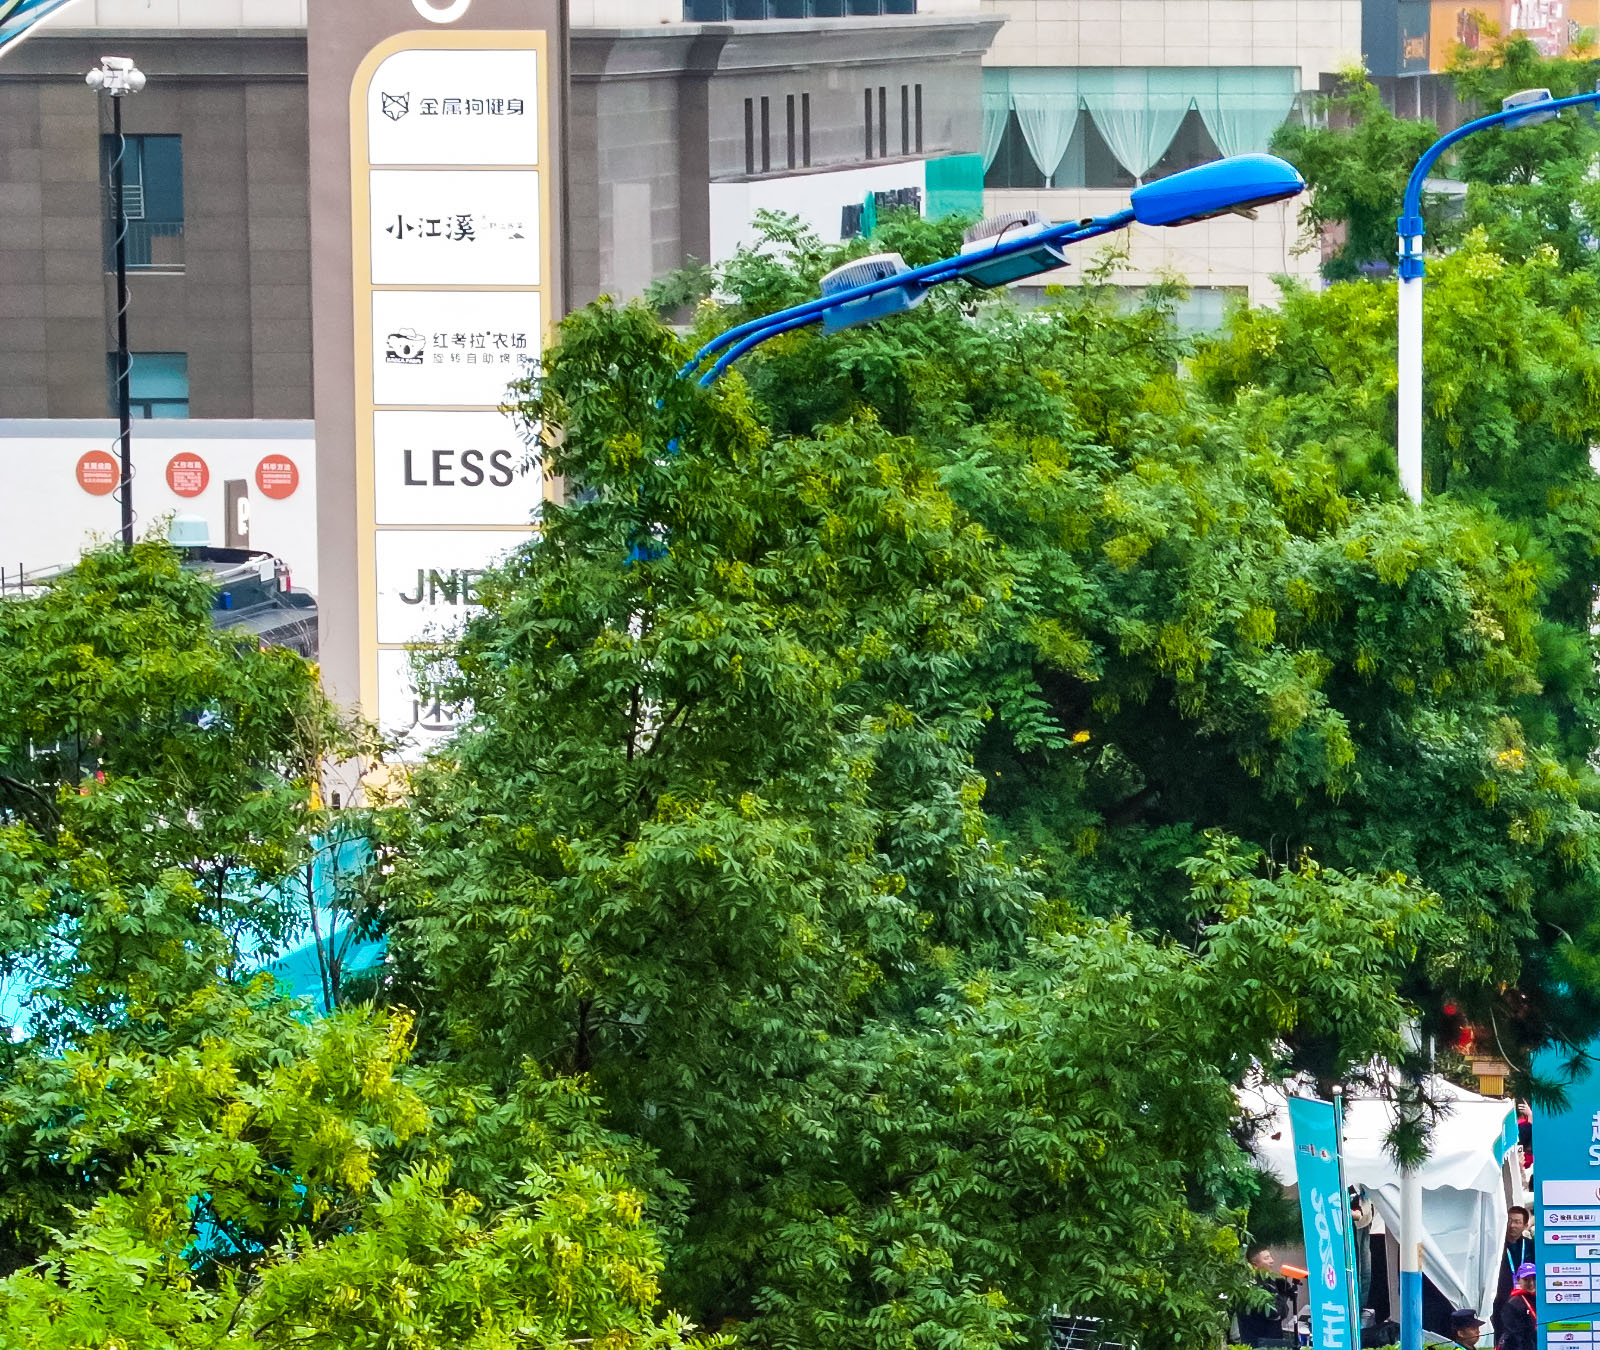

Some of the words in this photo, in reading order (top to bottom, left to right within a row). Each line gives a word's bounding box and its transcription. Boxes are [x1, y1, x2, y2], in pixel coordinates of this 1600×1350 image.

[419, 98, 524, 116] 金属狗健身
[385, 214, 476, 242] 小江溪
[404, 449, 514, 487] LESS
